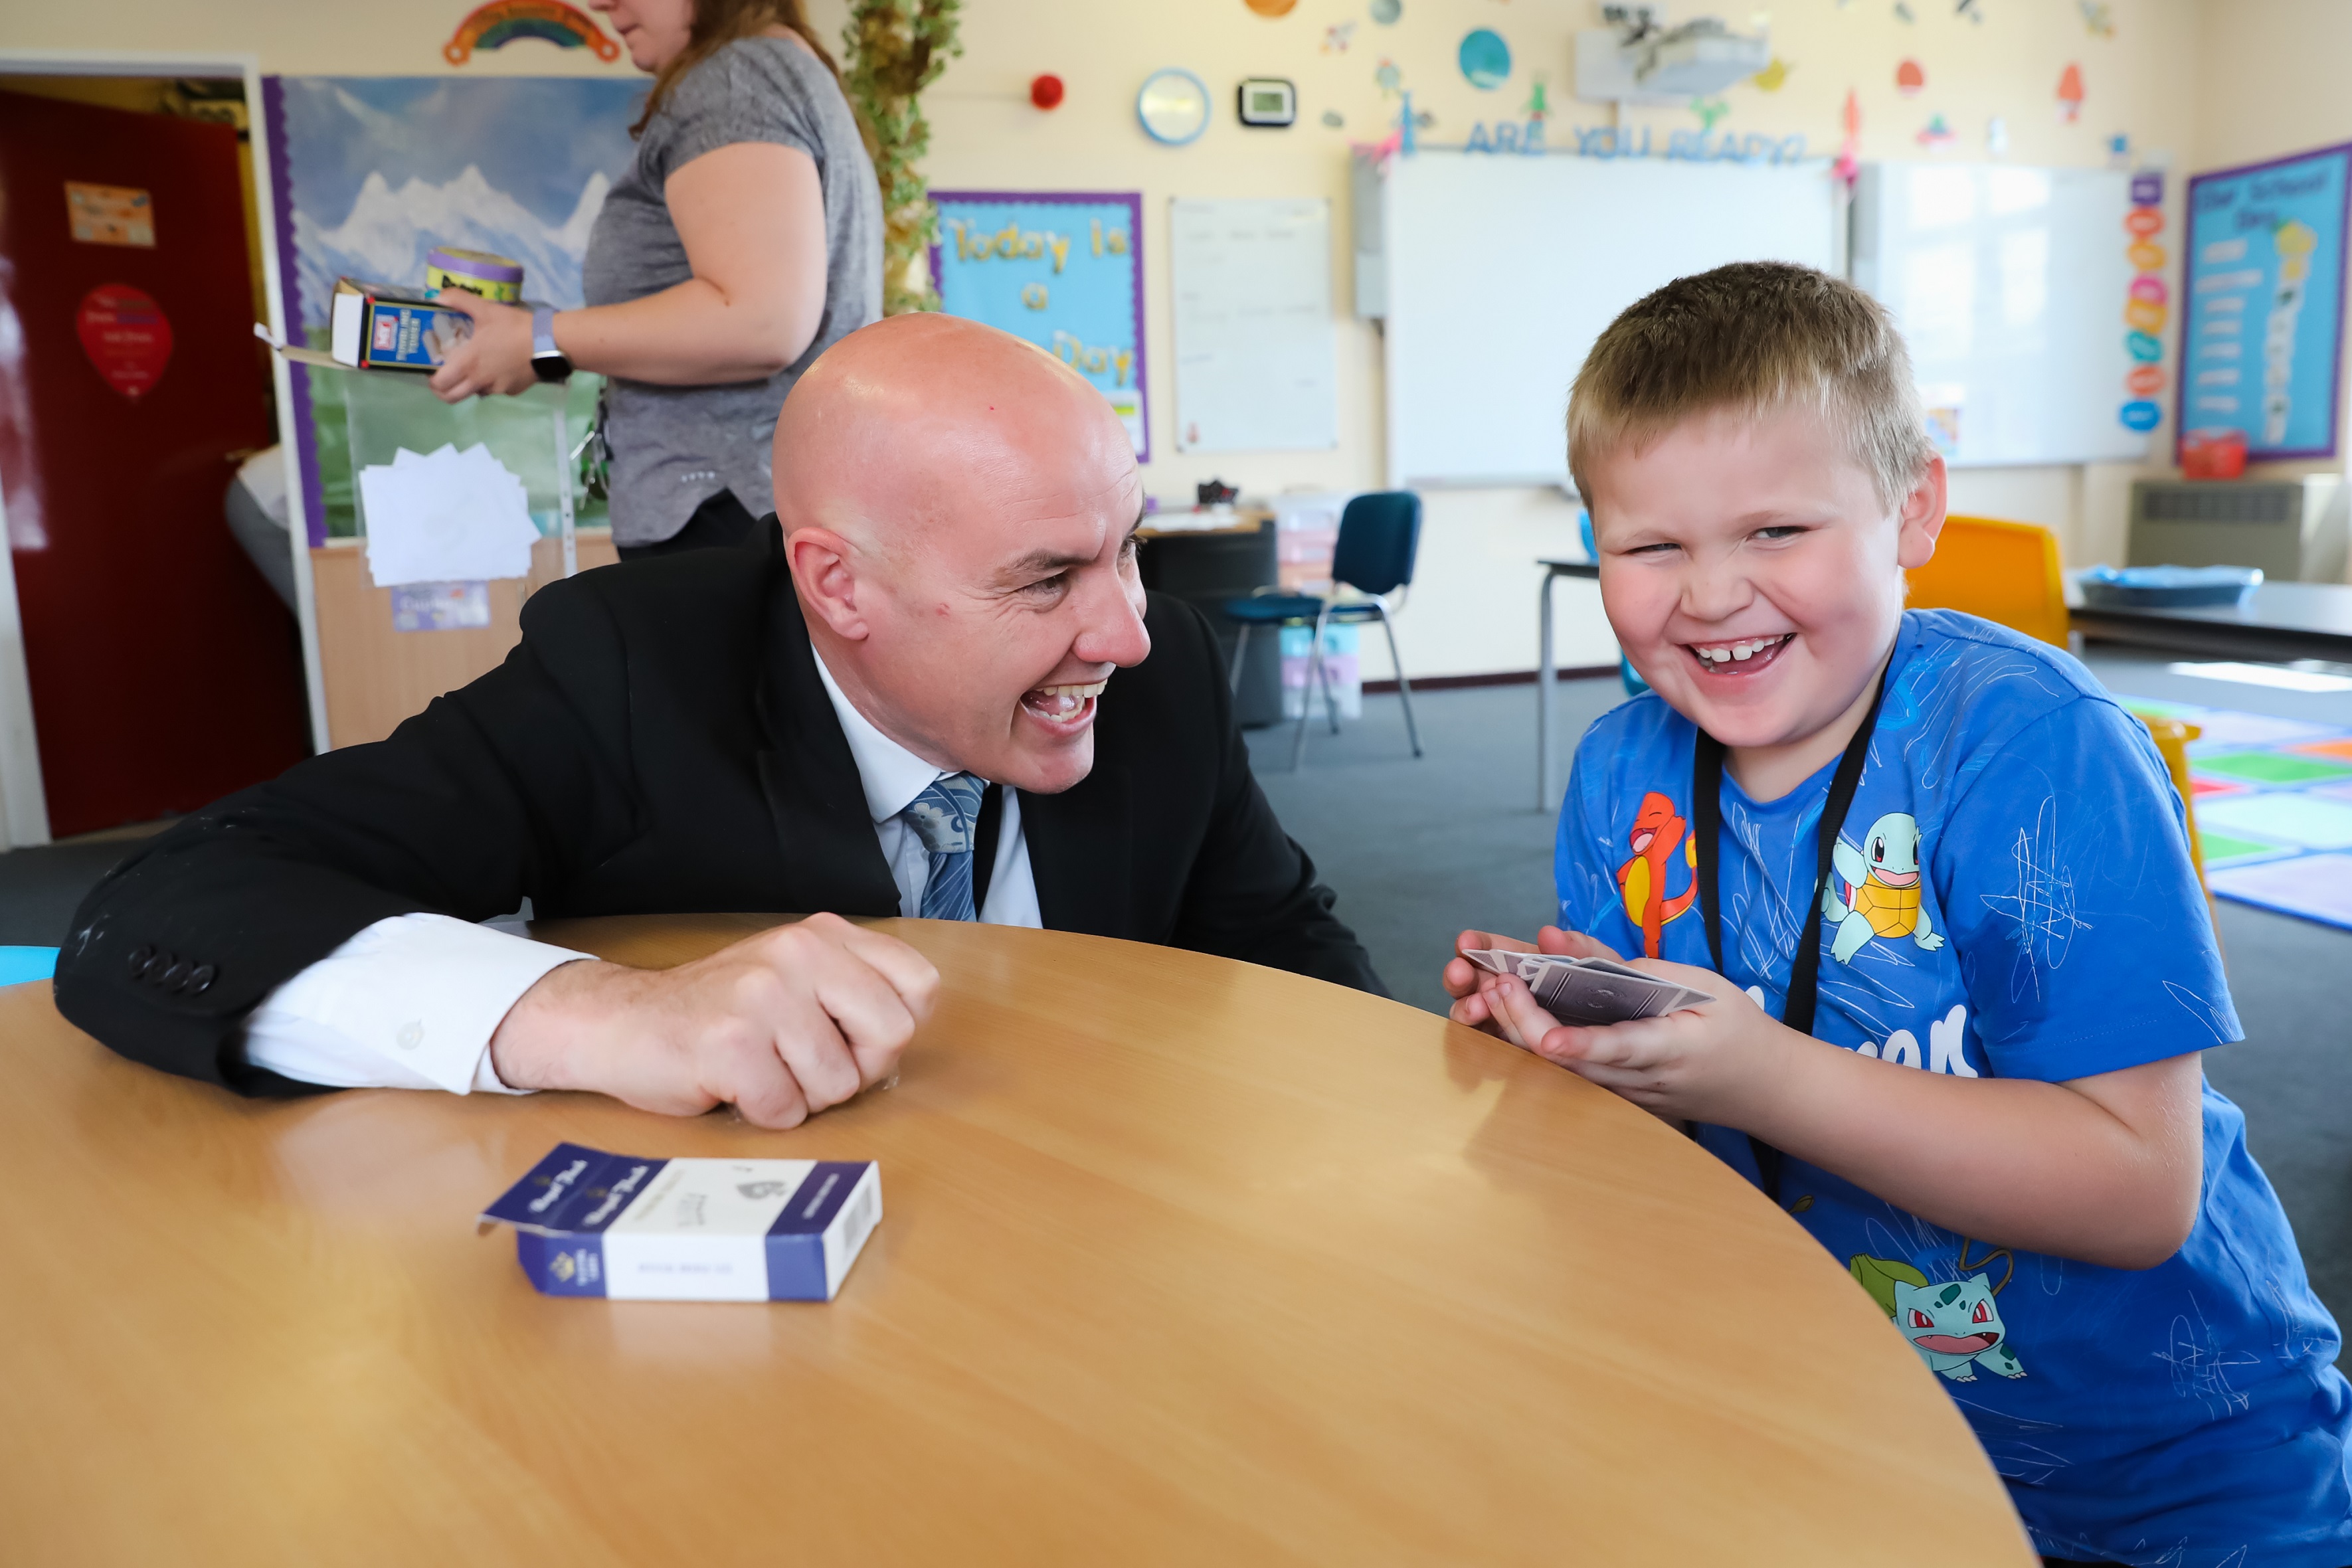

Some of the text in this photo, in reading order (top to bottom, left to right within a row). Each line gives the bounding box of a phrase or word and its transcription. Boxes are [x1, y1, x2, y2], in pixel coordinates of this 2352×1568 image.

[1465, 121, 1807, 167] ARE YOU READY?
[946, 218, 1069, 273] Today
[1021, 283, 1049, 311] a
[1053, 331, 1133, 386] Day
